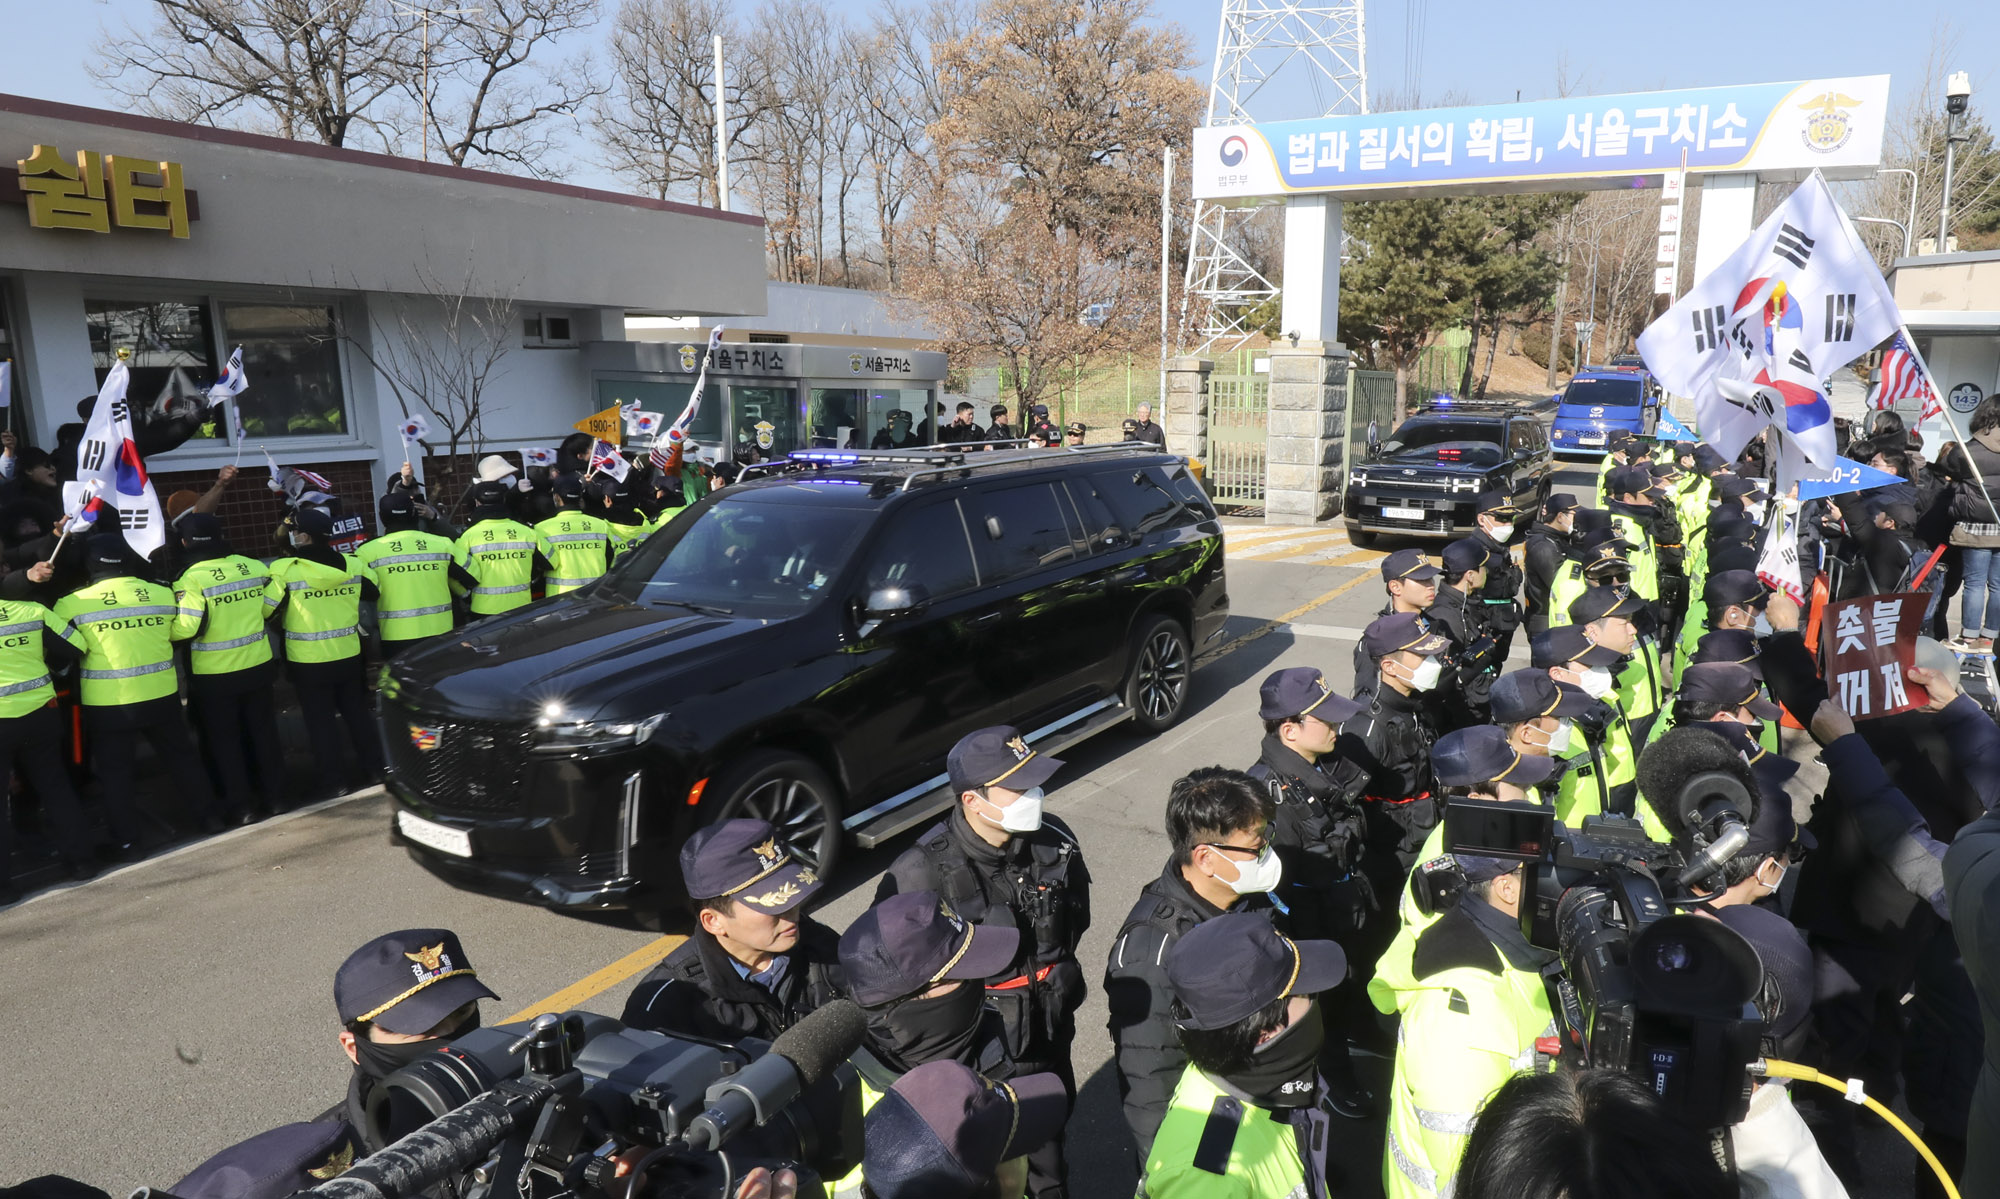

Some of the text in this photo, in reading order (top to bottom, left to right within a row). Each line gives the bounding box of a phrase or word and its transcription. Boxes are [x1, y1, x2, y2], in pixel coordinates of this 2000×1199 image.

[1288, 130, 1350, 175] 법과
[1359, 122, 1454, 171] 질서의
[1466, 117, 1544, 164] 확립,
[1557, 102, 1748, 158] 서울구치소
[1219, 174, 1248, 187] 법무부
[17, 144, 190, 239] 쉼터
[865, 356, 911, 373] 서울구치소
[1953, 395, 1978, 405] 143
[589, 419, 616, 432] 1900-1
[557, 542, 601, 551] POLICE
[481, 551, 527, 562] POLICE
[387, 563, 440, 574] POLICE
[213, 588, 264, 606] POLICE
[304, 586, 356, 600] POLICE
[97, 616, 165, 633] POLICE
[1836, 599, 1903, 655] 촛불
